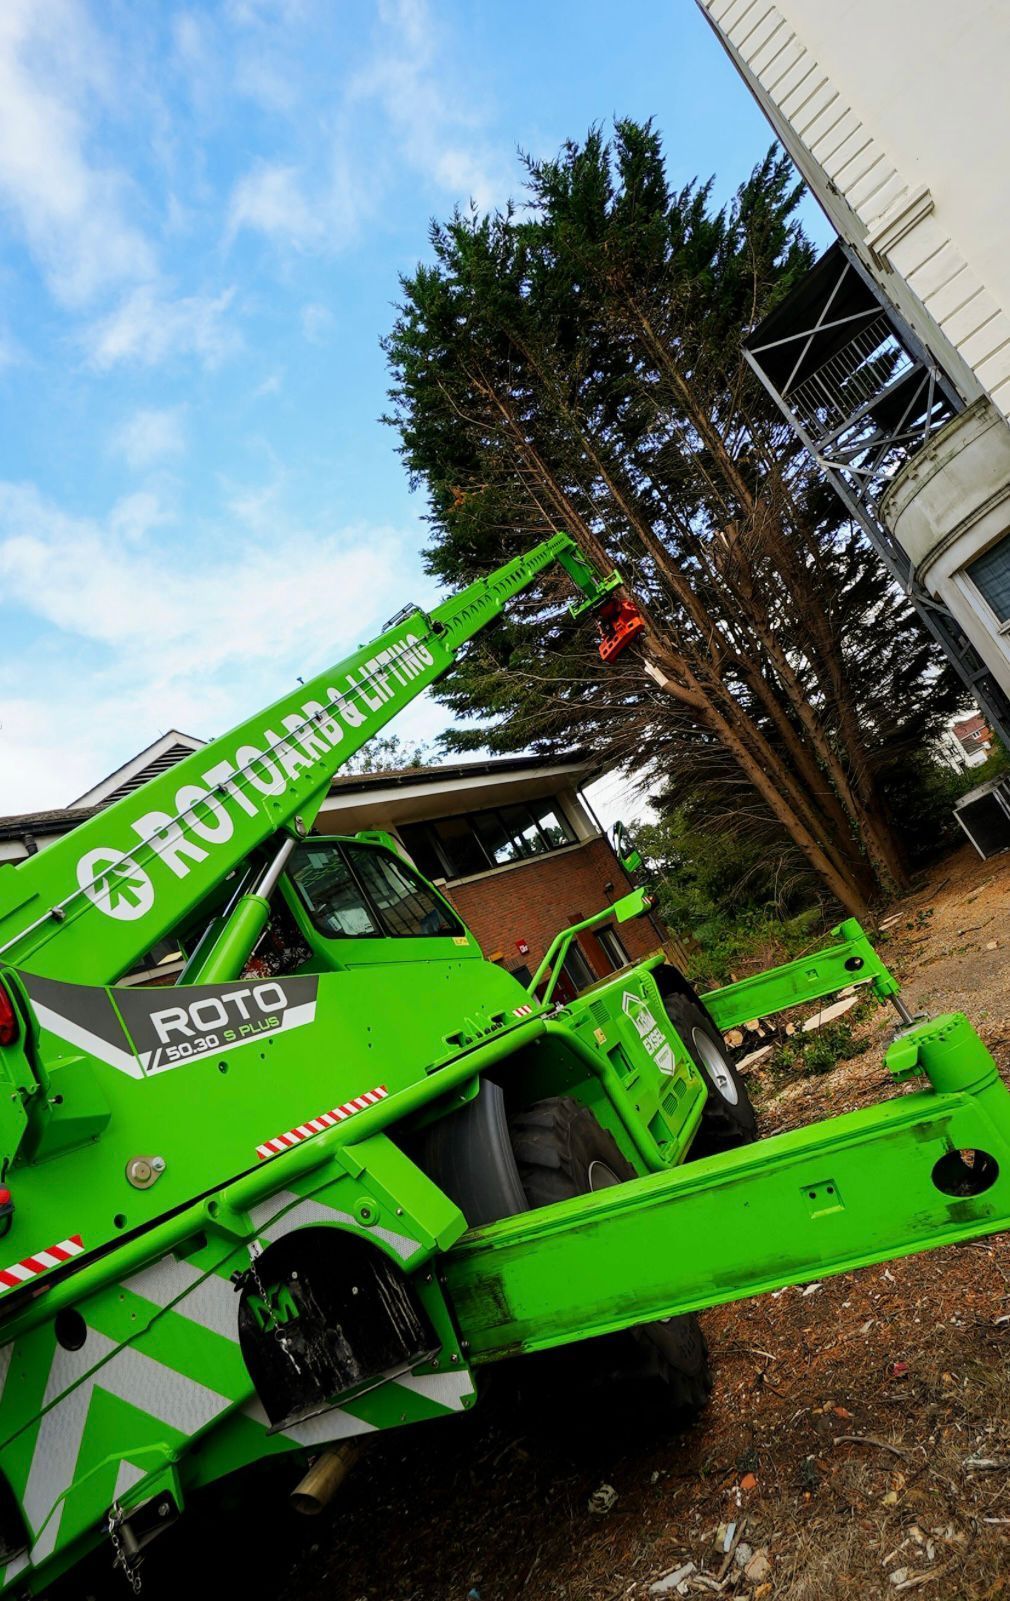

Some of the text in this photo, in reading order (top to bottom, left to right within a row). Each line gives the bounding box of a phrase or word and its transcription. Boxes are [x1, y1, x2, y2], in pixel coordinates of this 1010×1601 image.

[131, 633, 435, 879] ROTOARB & LIFTING
[150, 982, 288, 1044] ROTO
[223, 1030, 236, 1042] S
[239, 1016, 280, 1037] PLUS
